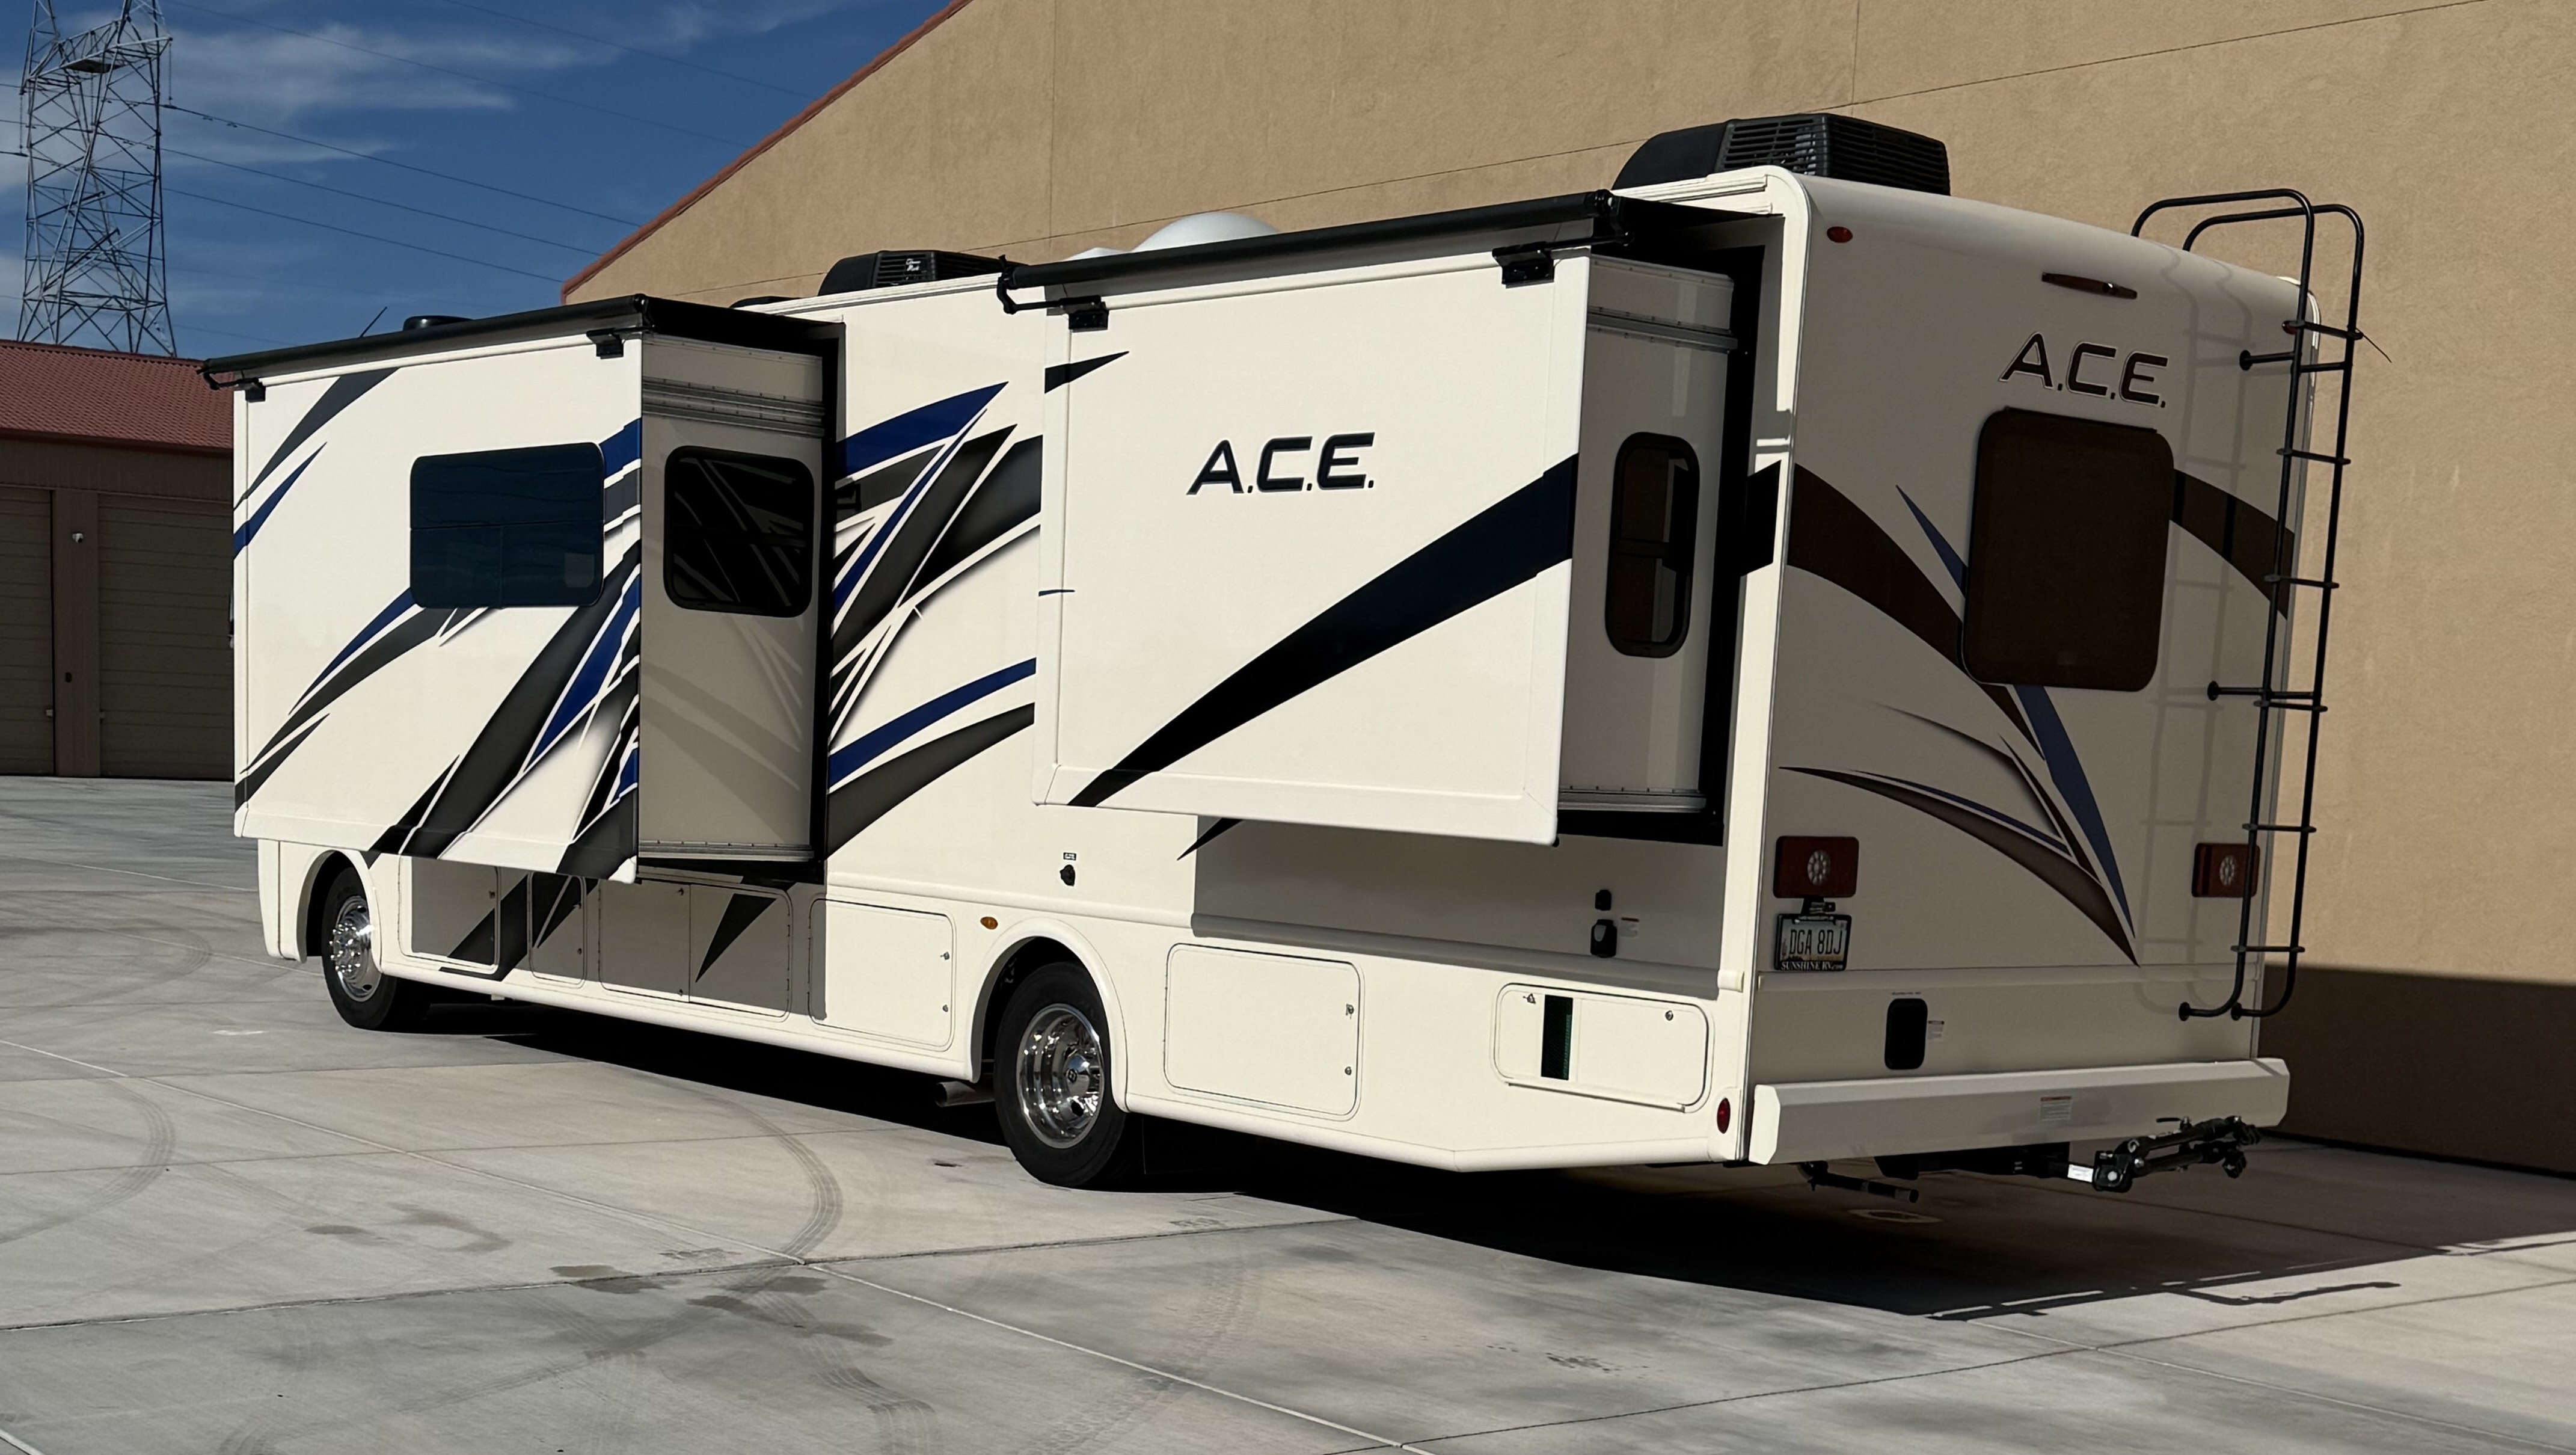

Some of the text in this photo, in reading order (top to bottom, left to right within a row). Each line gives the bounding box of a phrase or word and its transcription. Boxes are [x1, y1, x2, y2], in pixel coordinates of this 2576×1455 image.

[1998, 331, 2169, 408] A.C.E.
[1186, 432, 1376, 495] A.C.E.
[1789, 929, 1843, 955] DGA 8DJ
[1781, 961, 1820, 970] SUNSHINE
